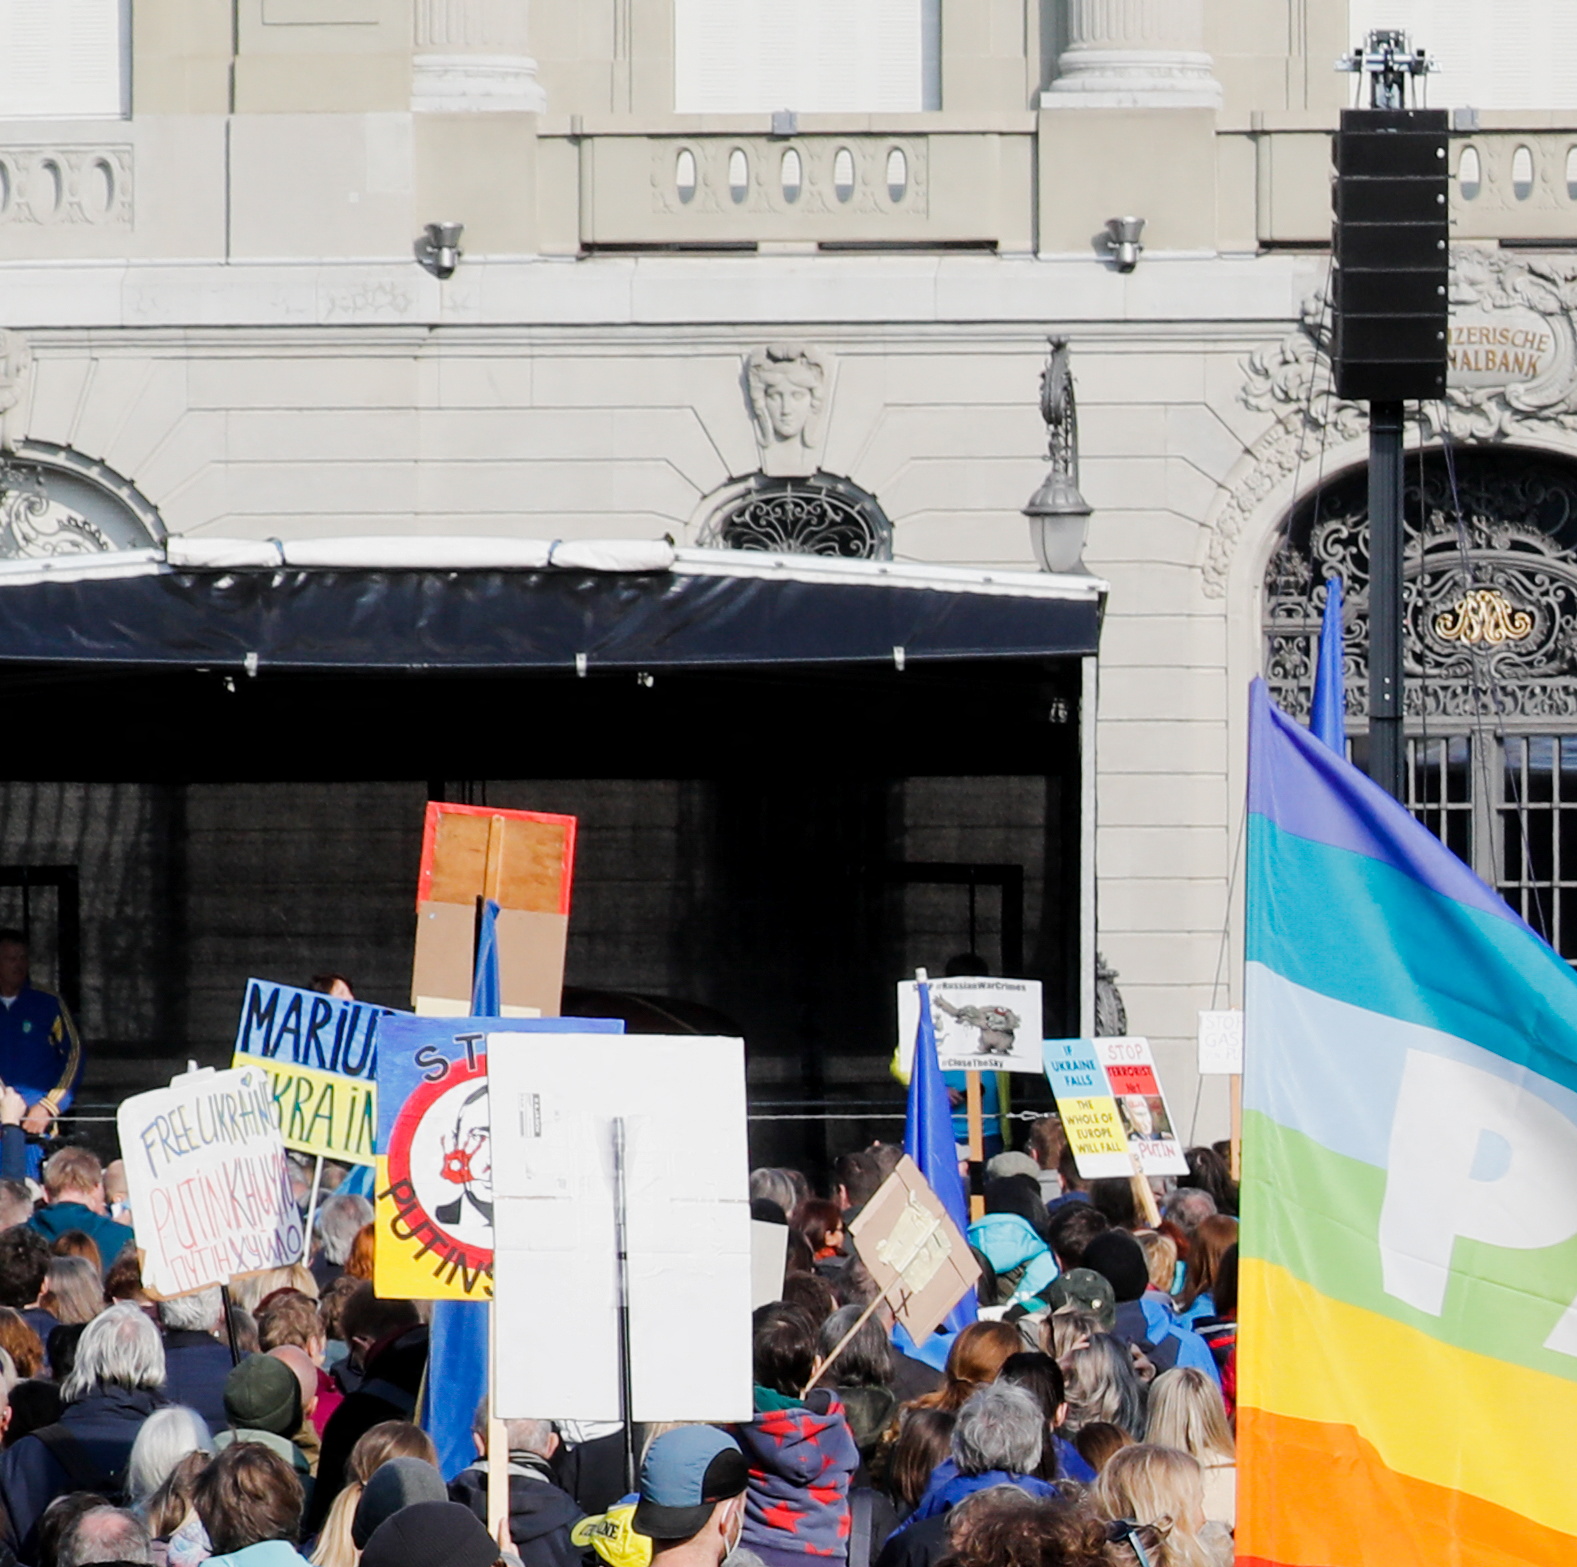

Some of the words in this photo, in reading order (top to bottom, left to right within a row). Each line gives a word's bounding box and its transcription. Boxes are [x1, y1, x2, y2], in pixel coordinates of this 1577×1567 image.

[1062, 1045, 1073, 1056] IF
[1107, 1044, 1144, 1060] STOP
[1051, 1060, 1097, 1072] UKRAINE
[1107, 1065, 1152, 1077] TERRORIST
[1065, 1075, 1093, 1086] FALLS
[1077, 1100, 1094, 1110] THE
[1065, 1113, 1099, 1125] WHOLE
[1100, 1113, 1113, 1124] OF
[1076, 1127, 1113, 1139] EUROPE
[1076, 1142, 1099, 1153] WILL
[1100, 1142, 1122, 1153] FALL
